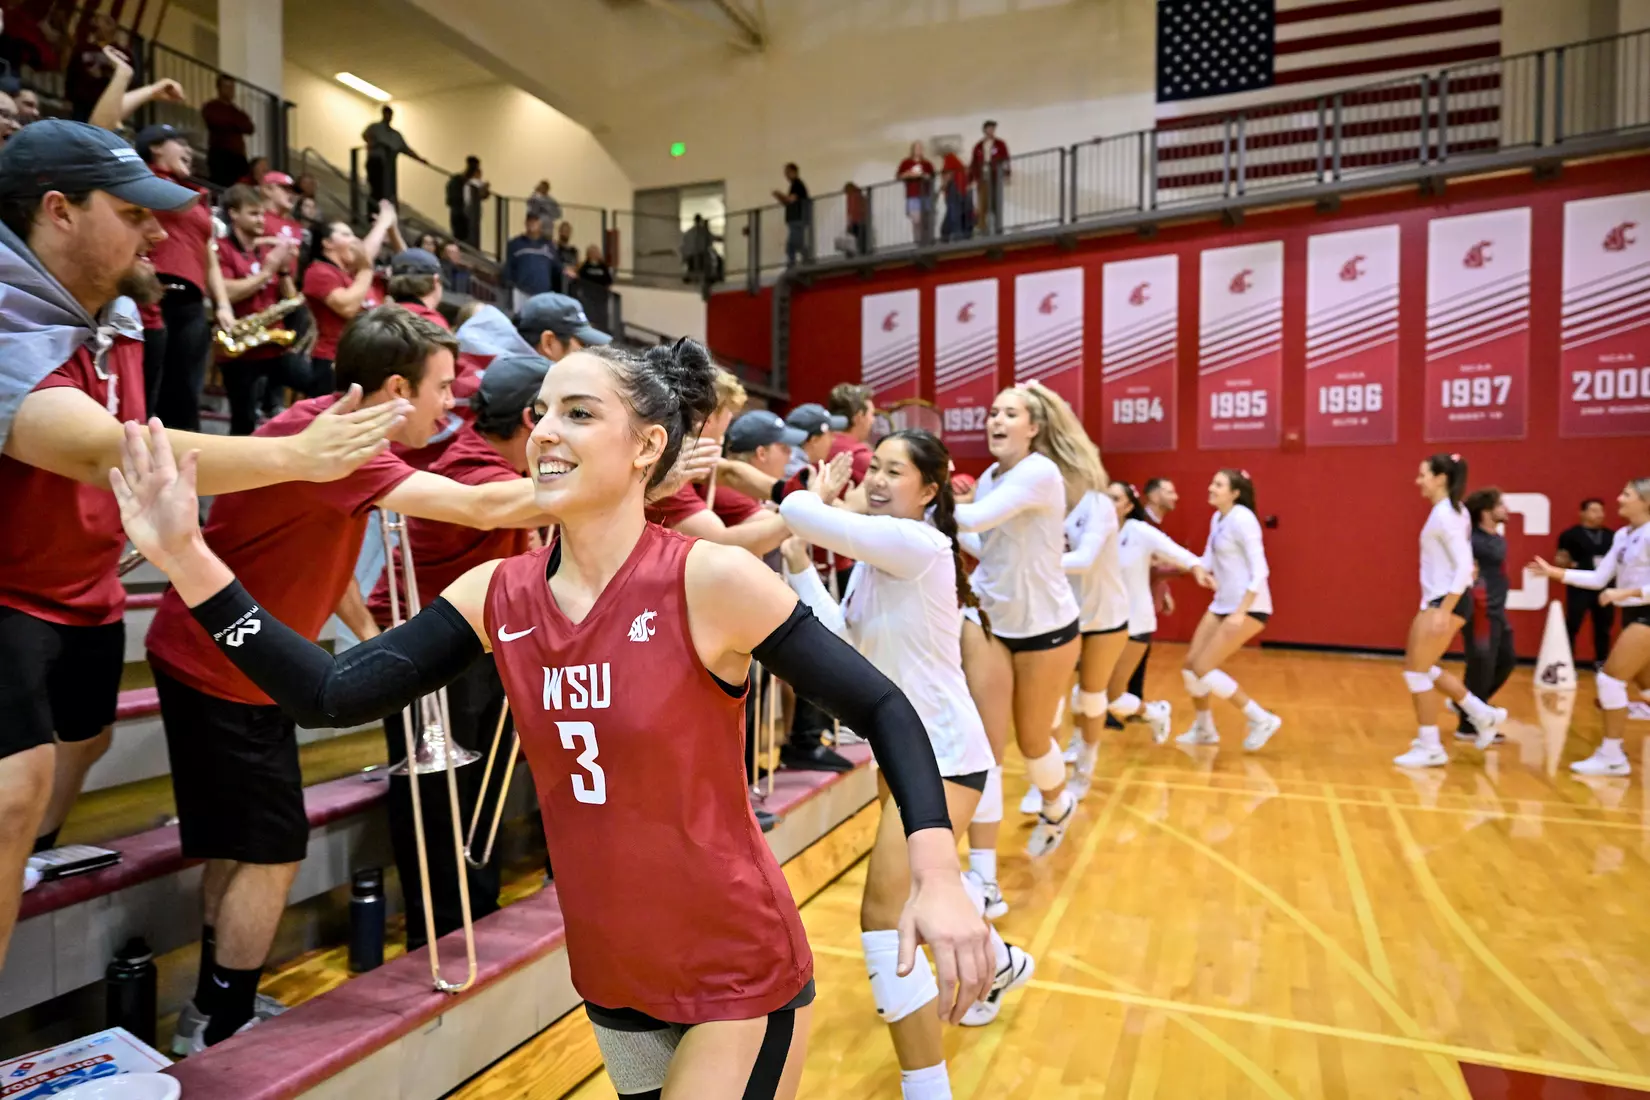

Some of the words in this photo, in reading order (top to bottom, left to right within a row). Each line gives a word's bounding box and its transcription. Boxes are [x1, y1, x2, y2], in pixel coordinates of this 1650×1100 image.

[1210, 389, 1268, 419] 1995
[1318, 383, 1383, 414] 1996
[1441, 375, 1512, 408] 1997
[943, 406, 987, 431] 1992
[1112, 396, 1165, 424] 1994
[542, 662, 611, 710] WSU
[553, 721, 607, 805] 3
[1, 1073, 50, 1095] YOUR
[53, 1054, 106, 1076] SLICE
